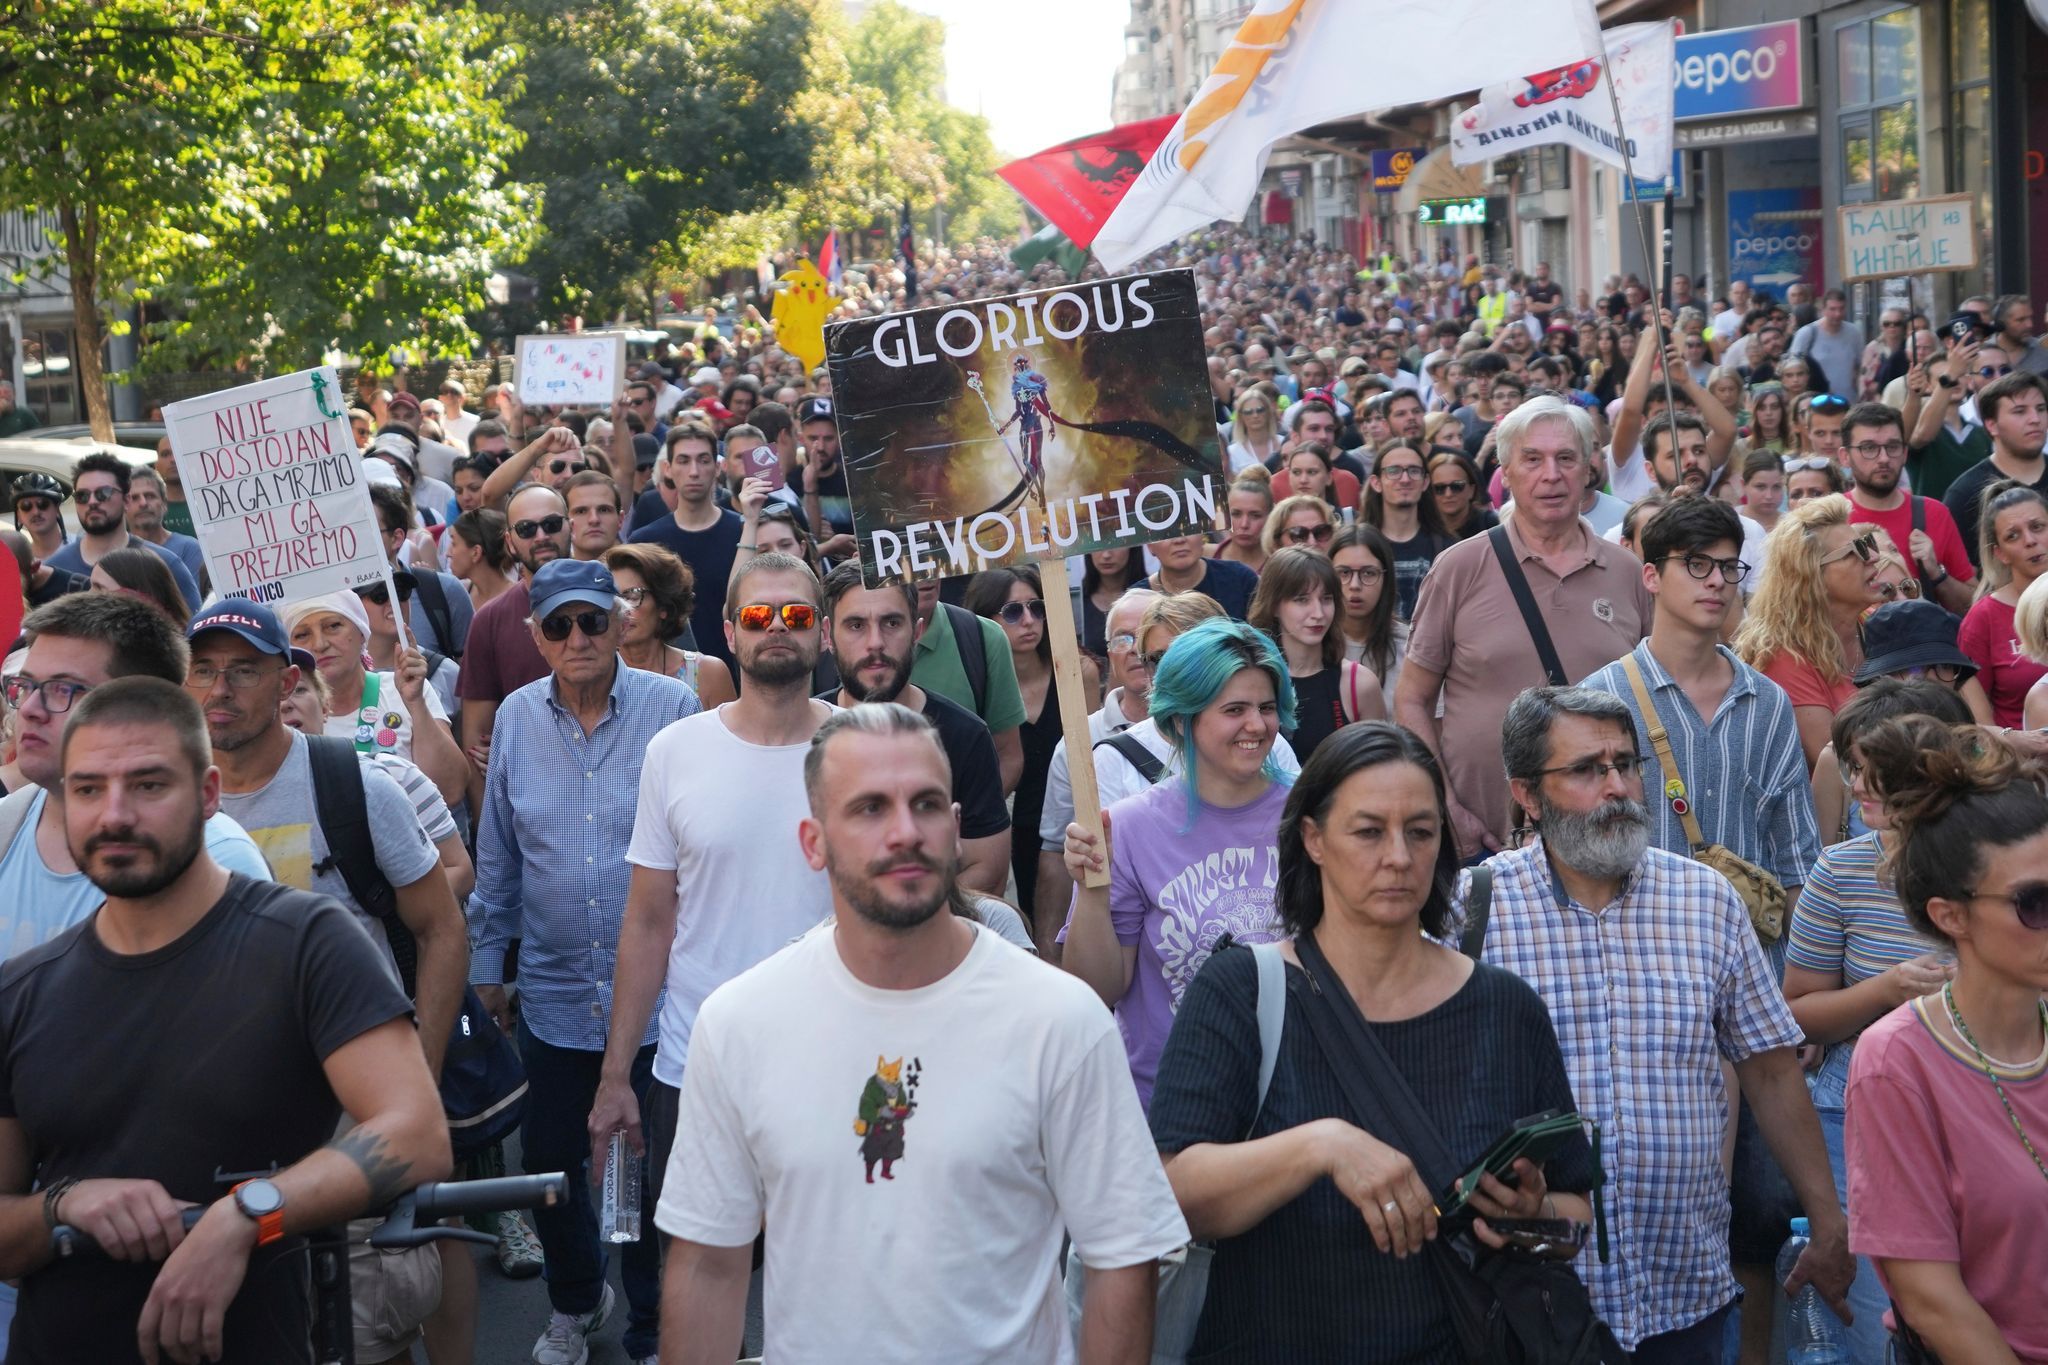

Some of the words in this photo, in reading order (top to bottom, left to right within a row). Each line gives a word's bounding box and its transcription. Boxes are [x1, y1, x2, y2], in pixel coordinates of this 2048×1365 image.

[1692, 126, 1722, 141] ULAZ
[1725, 124, 1741, 138] ZA
[1743, 120, 1786, 136] VOZILA
[1735, 234, 1813, 257] pepco
[872, 277, 1155, 367] GLORIOUS
[200, 422, 332, 484] DOSTOJAN
[214, 400, 276, 445] NIJE
[201, 484, 237, 521] DA
[238, 476, 271, 512] GA
[272, 453, 355, 503] MRZIMO
[244, 510, 278, 548] MI
[290, 499, 326, 535] GA
[871, 474, 1217, 578] REVOLUTION
[230, 525, 357, 588] PREZIREMO
[1158, 846, 1255, 934] SUNSET
[606, 1143, 615, 1201] VODAVODA
